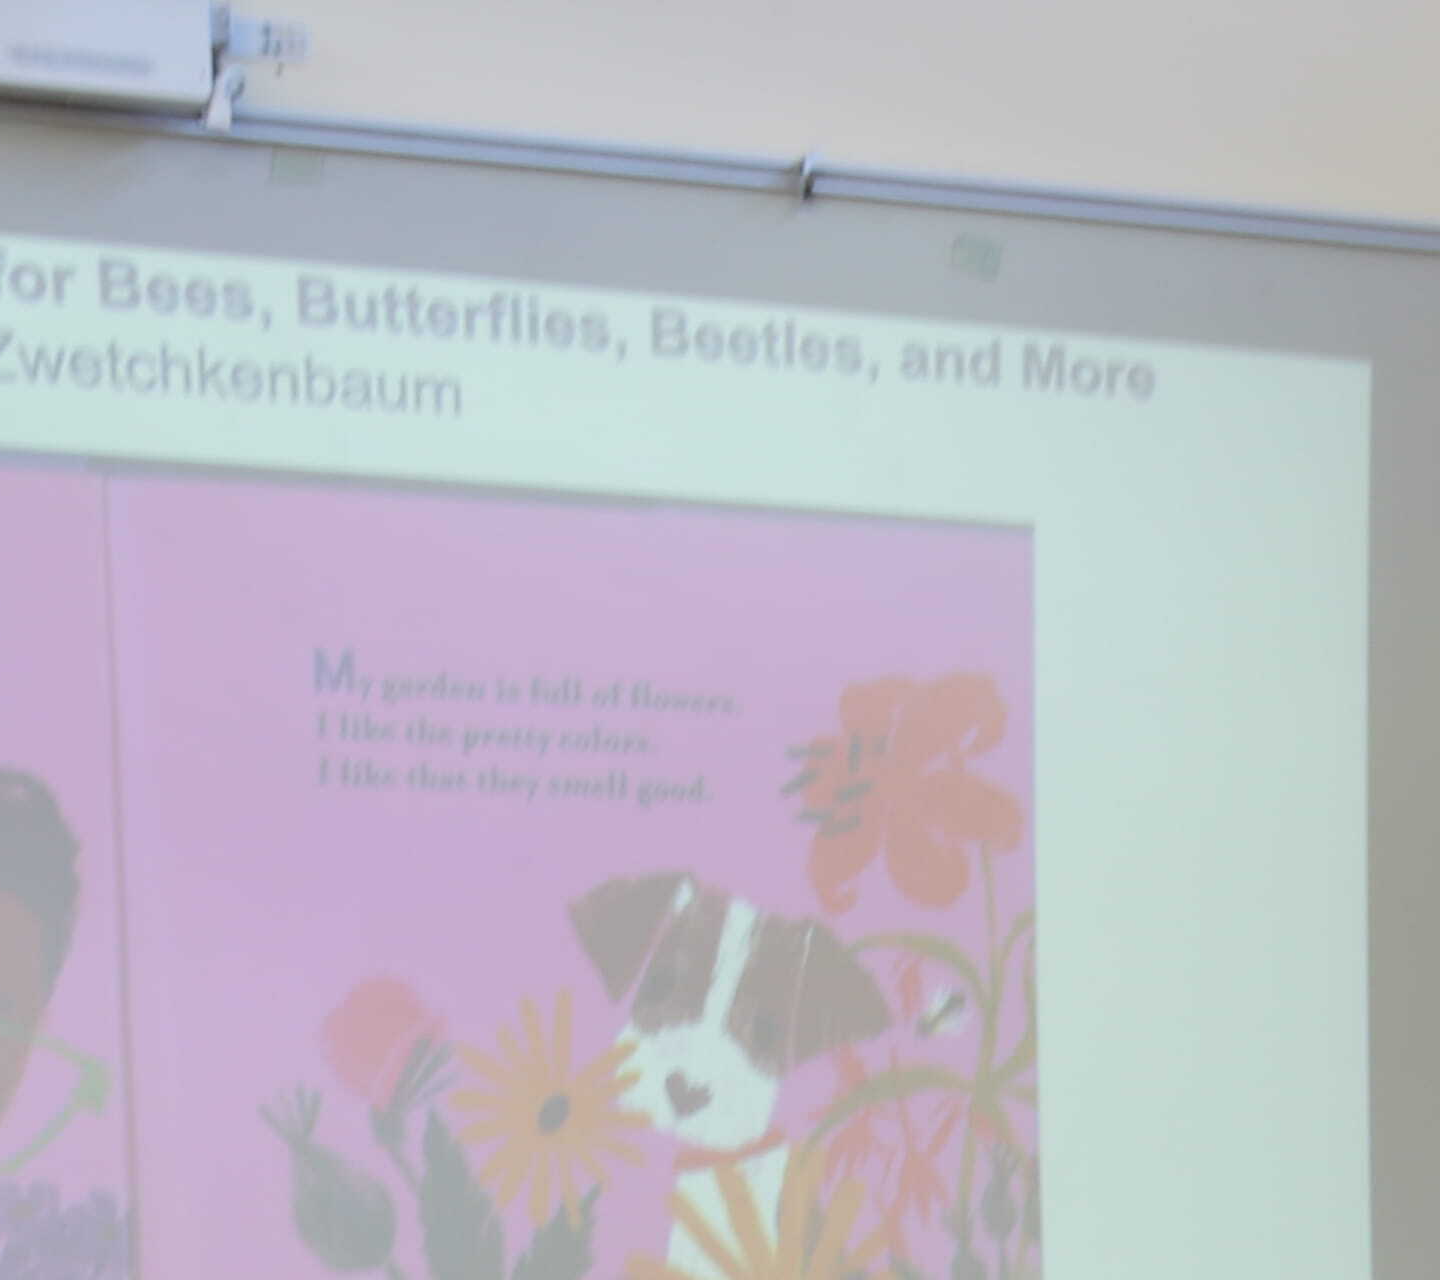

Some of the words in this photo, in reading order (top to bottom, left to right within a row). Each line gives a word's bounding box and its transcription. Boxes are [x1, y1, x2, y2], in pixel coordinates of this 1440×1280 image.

[99, 256, 279, 331] Bees,
[298, 275, 631, 363] Butterflies,
[650, 308, 883, 384] Beetles,
[900, 334, 1007, 387] and
[1022, 345, 1158, 402] More
[313, 645, 372, 701] My
[380, 669, 486, 706] garden
